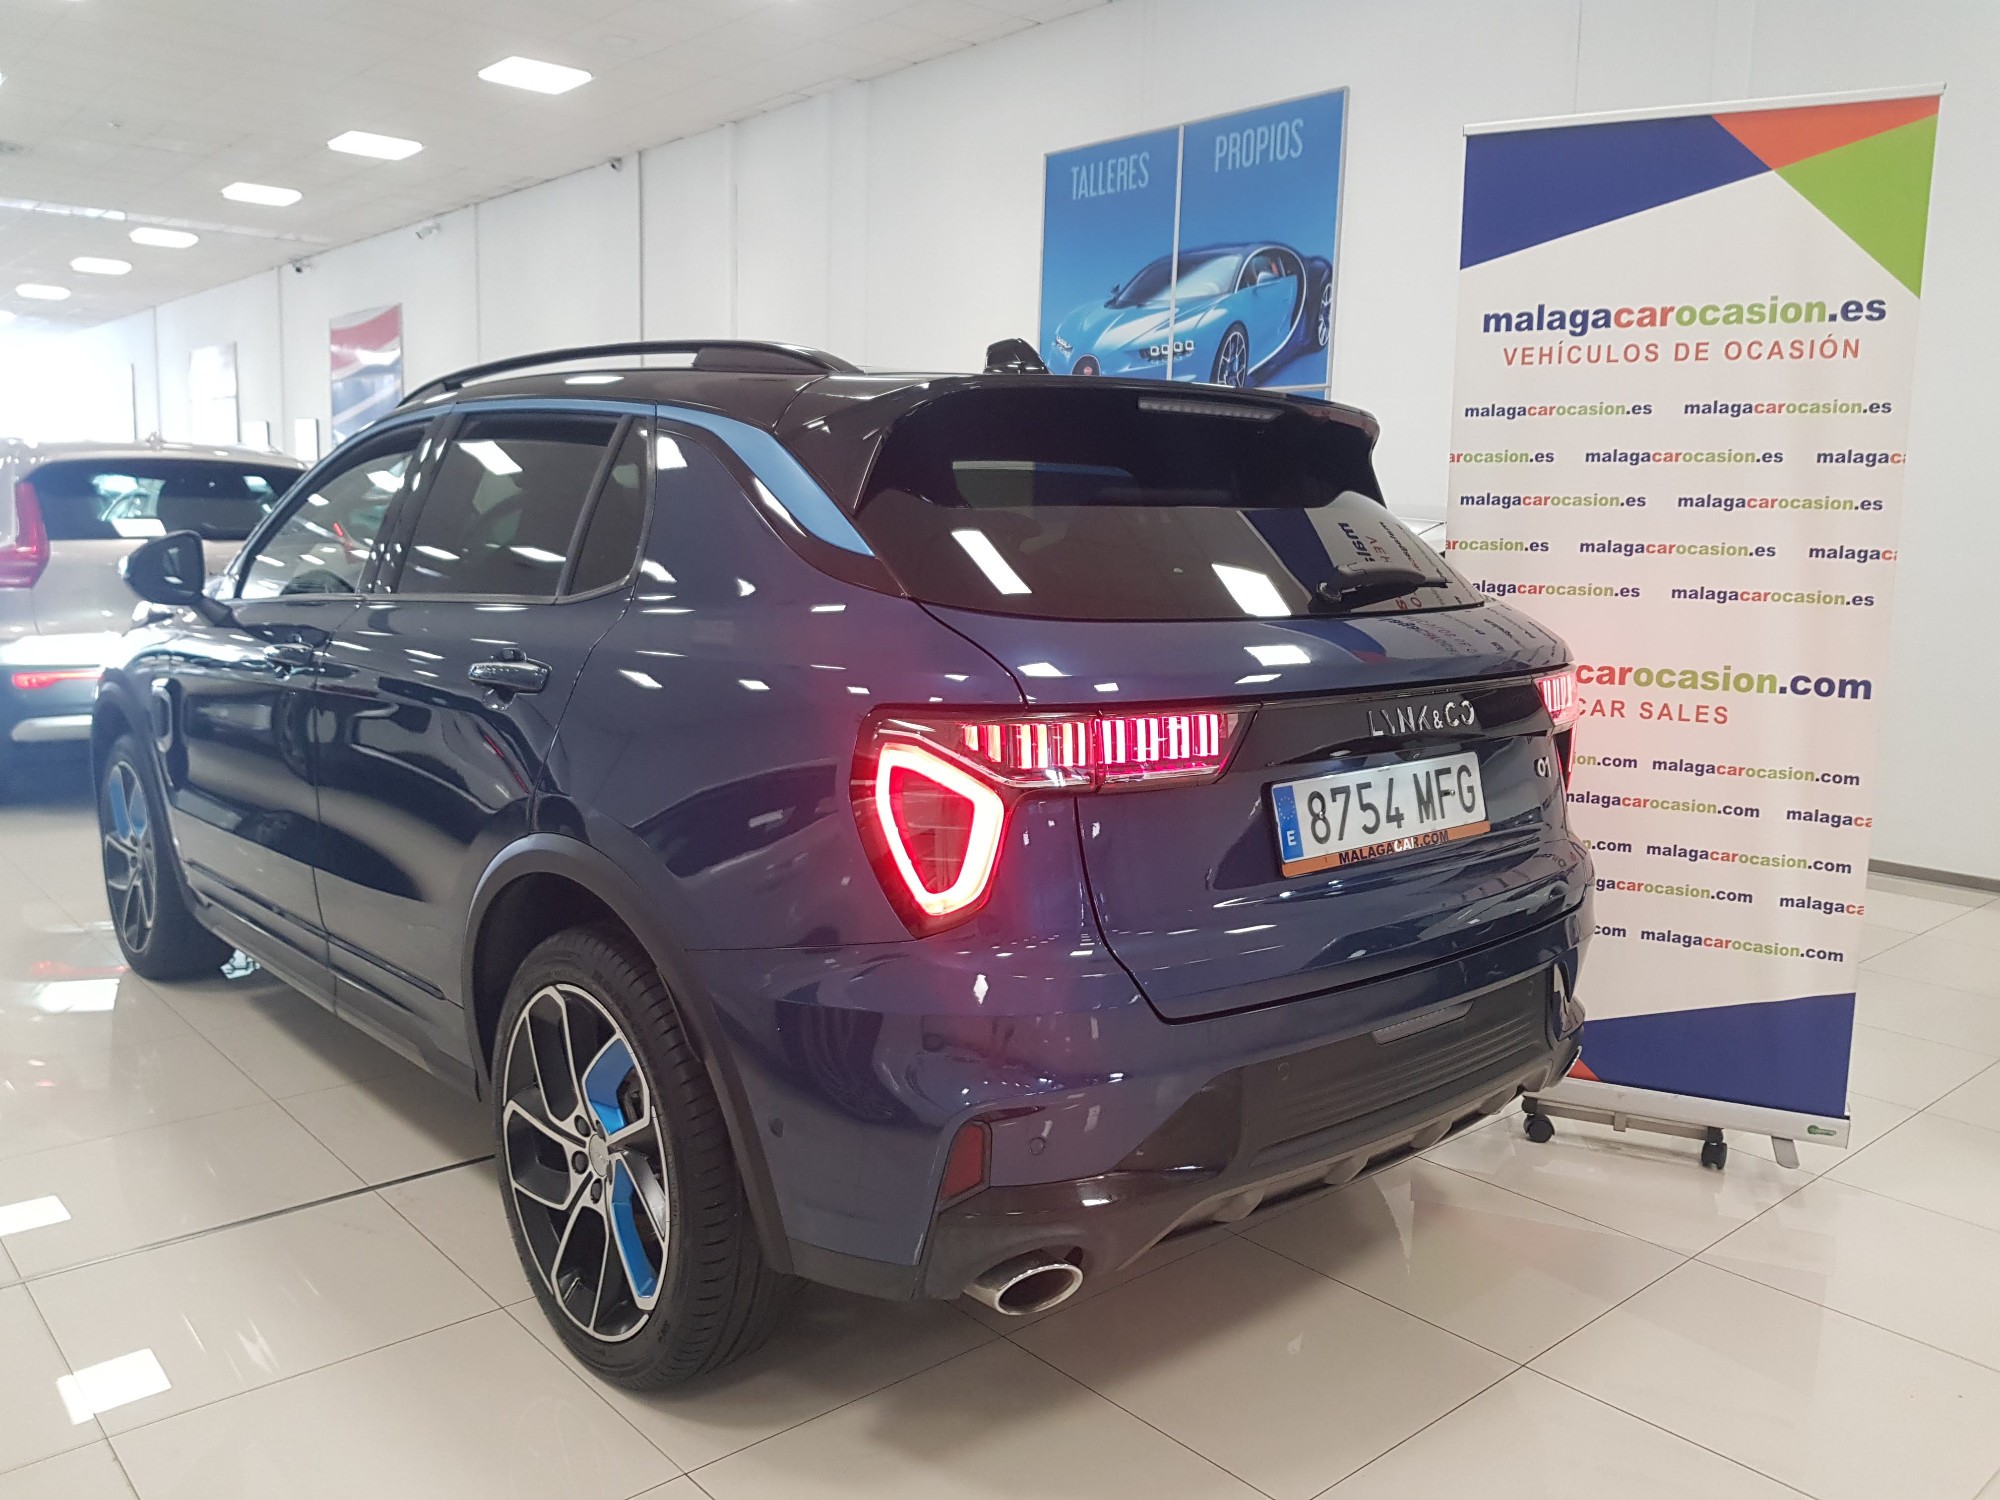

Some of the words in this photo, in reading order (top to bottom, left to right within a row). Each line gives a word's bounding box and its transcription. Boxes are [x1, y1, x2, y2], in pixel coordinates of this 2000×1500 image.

[1071, 152, 1150, 200] TALLERES
[1214, 118, 1304, 173] PROPIOS
[1483, 296, 1886, 337] malagacarocasion.es
[1504, 342, 1658, 366] VEHÍCULOS
[1674, 342, 1709, 361] DE
[1725, 334, 1859, 360] OCASIÓN
[1465, 402, 1652, 420] malagacarocasion.es
[1684, 400, 1891, 417] malagacarocasion.es
[1586, 449, 1783, 466] malagacarocasion.es
[1460, 493, 1646, 509] malagacarocasion.es
[1678, 494, 1882, 511] malagacarocasion.es
[1580, 540, 1776, 557] malagacarocasion.es
[1672, 586, 1874, 606] malagacarocasion.es
[1639, 702, 1727, 724] SALES
[1653, 759, 1859, 785] malagacarocasion.com
[1307, 777, 1404, 845] 8754
[1412, 764, 1476, 824] MFG
[1286, 830, 1297, 846] E
[1338, 830, 1449, 865] MALAGACAR.COM
[1647, 845, 1851, 874] malagacarocasion.com
[1641, 930, 1843, 962] malagacarocasion.com
